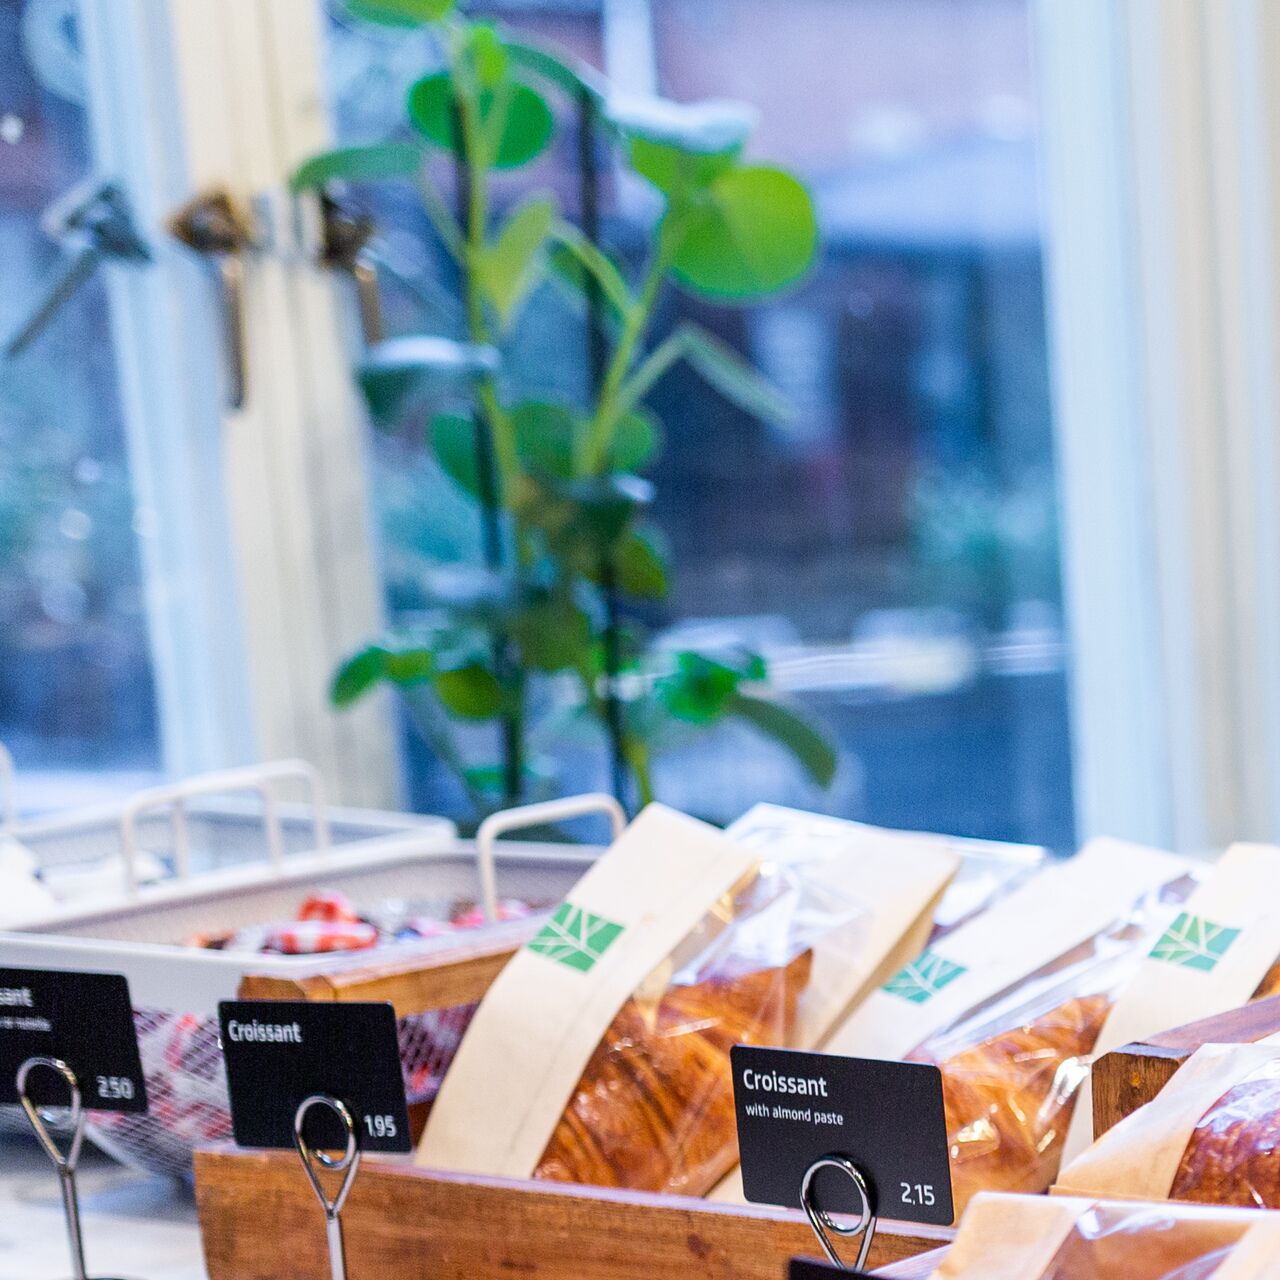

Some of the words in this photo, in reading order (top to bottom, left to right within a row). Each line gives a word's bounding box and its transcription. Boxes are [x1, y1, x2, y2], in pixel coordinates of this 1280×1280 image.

[228, 1020, 302, 1043] Croissant
[743, 1069, 828, 1097] Croissant
[745, 1104, 770, 1118] with
[772, 1105, 811, 1122] almond
[814, 1109, 844, 1125] paste
